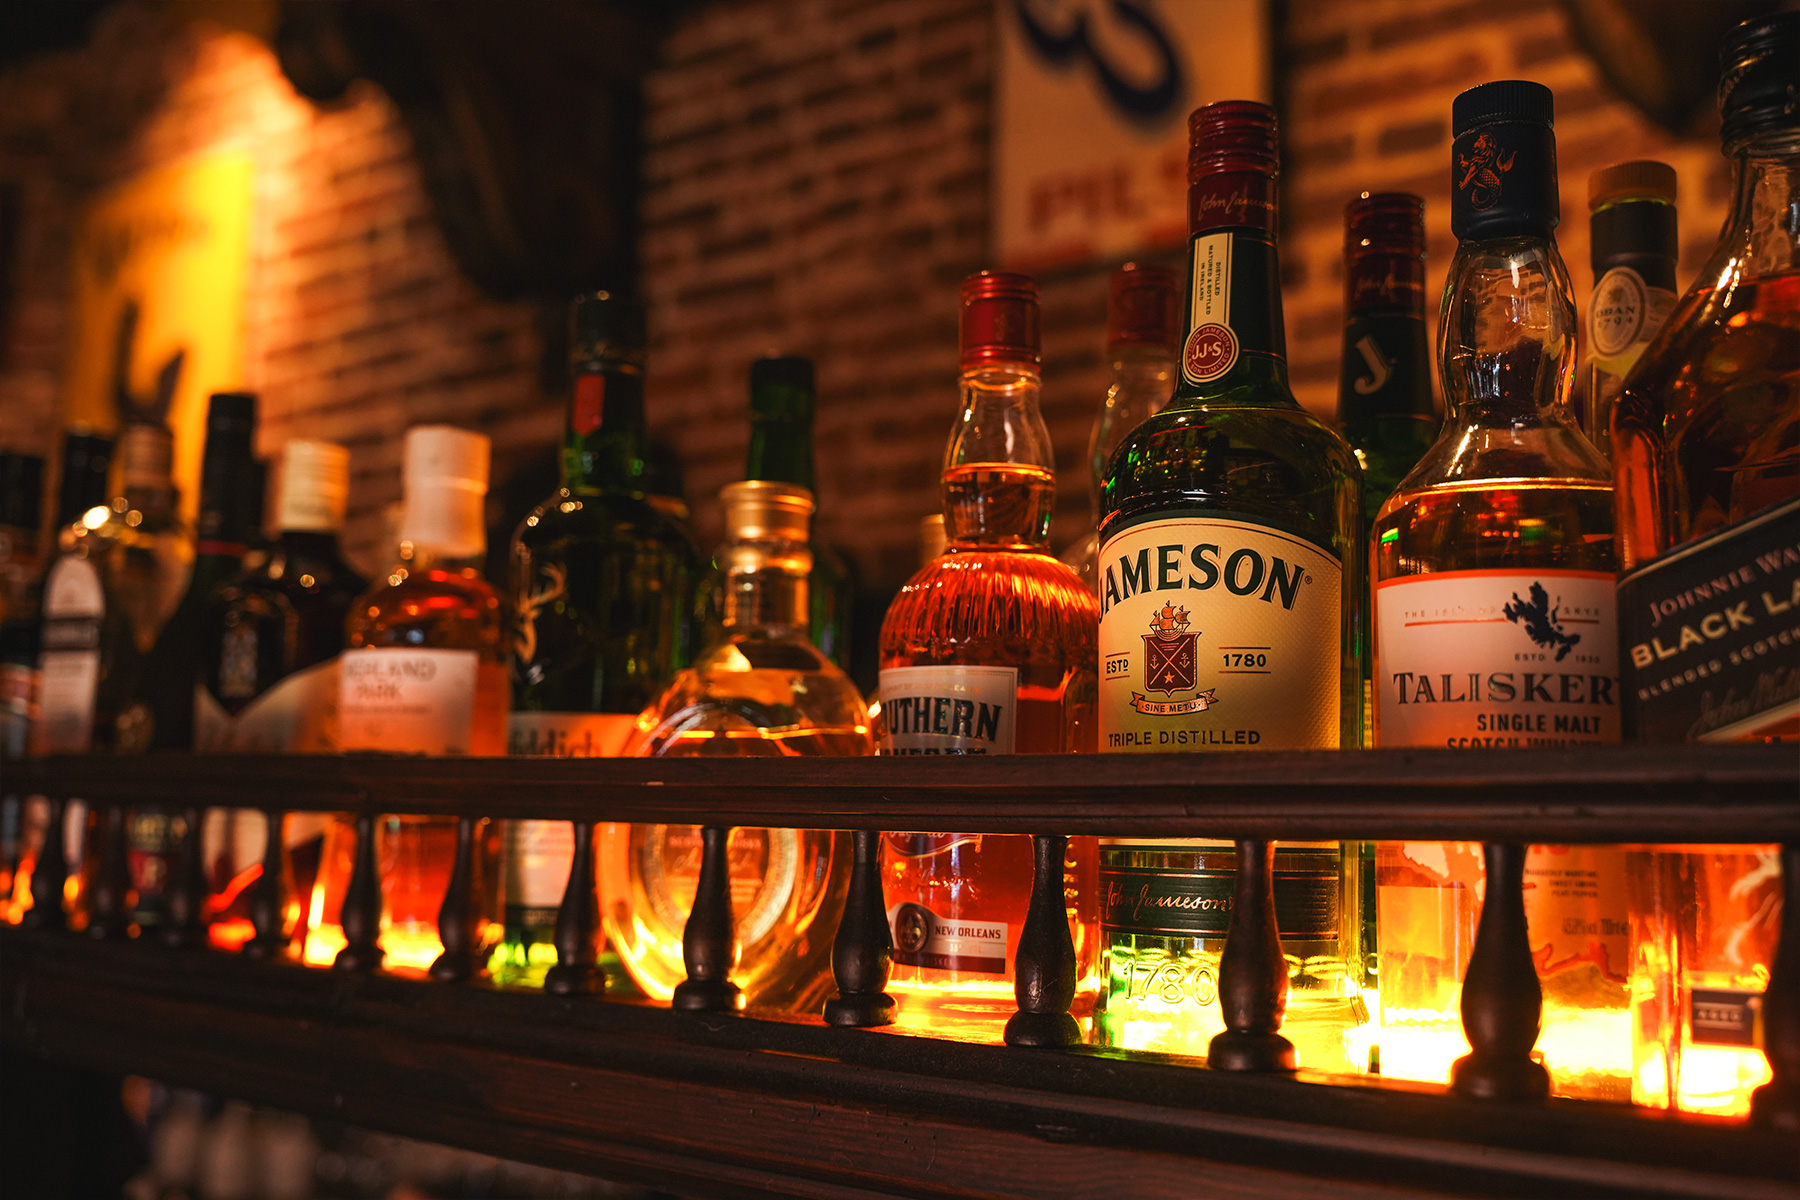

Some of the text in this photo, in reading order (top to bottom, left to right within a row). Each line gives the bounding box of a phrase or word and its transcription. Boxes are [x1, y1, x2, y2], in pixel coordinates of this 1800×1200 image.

[1201, 262, 1205, 270] IN
[1188, 327, 1231, 352] JOHN JAMESON
[1191, 341, 1222, 360] JJ&S
[1190, 364, 1202, 374] SON
[1203, 352, 1230, 374] LIMITED
[1099, 543, 1305, 625] JAMESON
[1650, 542, 1800, 628] JOHNNIE WA
[1630, 601, 1755, 670] BLACK
[1223, 653, 1267, 667] 1780
[1393, 671, 1615, 706] TALISKER
[1638, 659, 1722, 700] BLENDED
[880, 697, 1002, 742] OUTHERN
[1145, 702, 1198, 713] SINE METU
[1477, 713, 1600, 735] SINGLE MALT
[1109, 730, 1261, 748] TRIPLE DISTILLED
[1106, 881, 1227, 921] John Jameson
[935, 925, 1001, 939] NEW ORLEANS
[1124, 962, 1217, 1006] 1780
